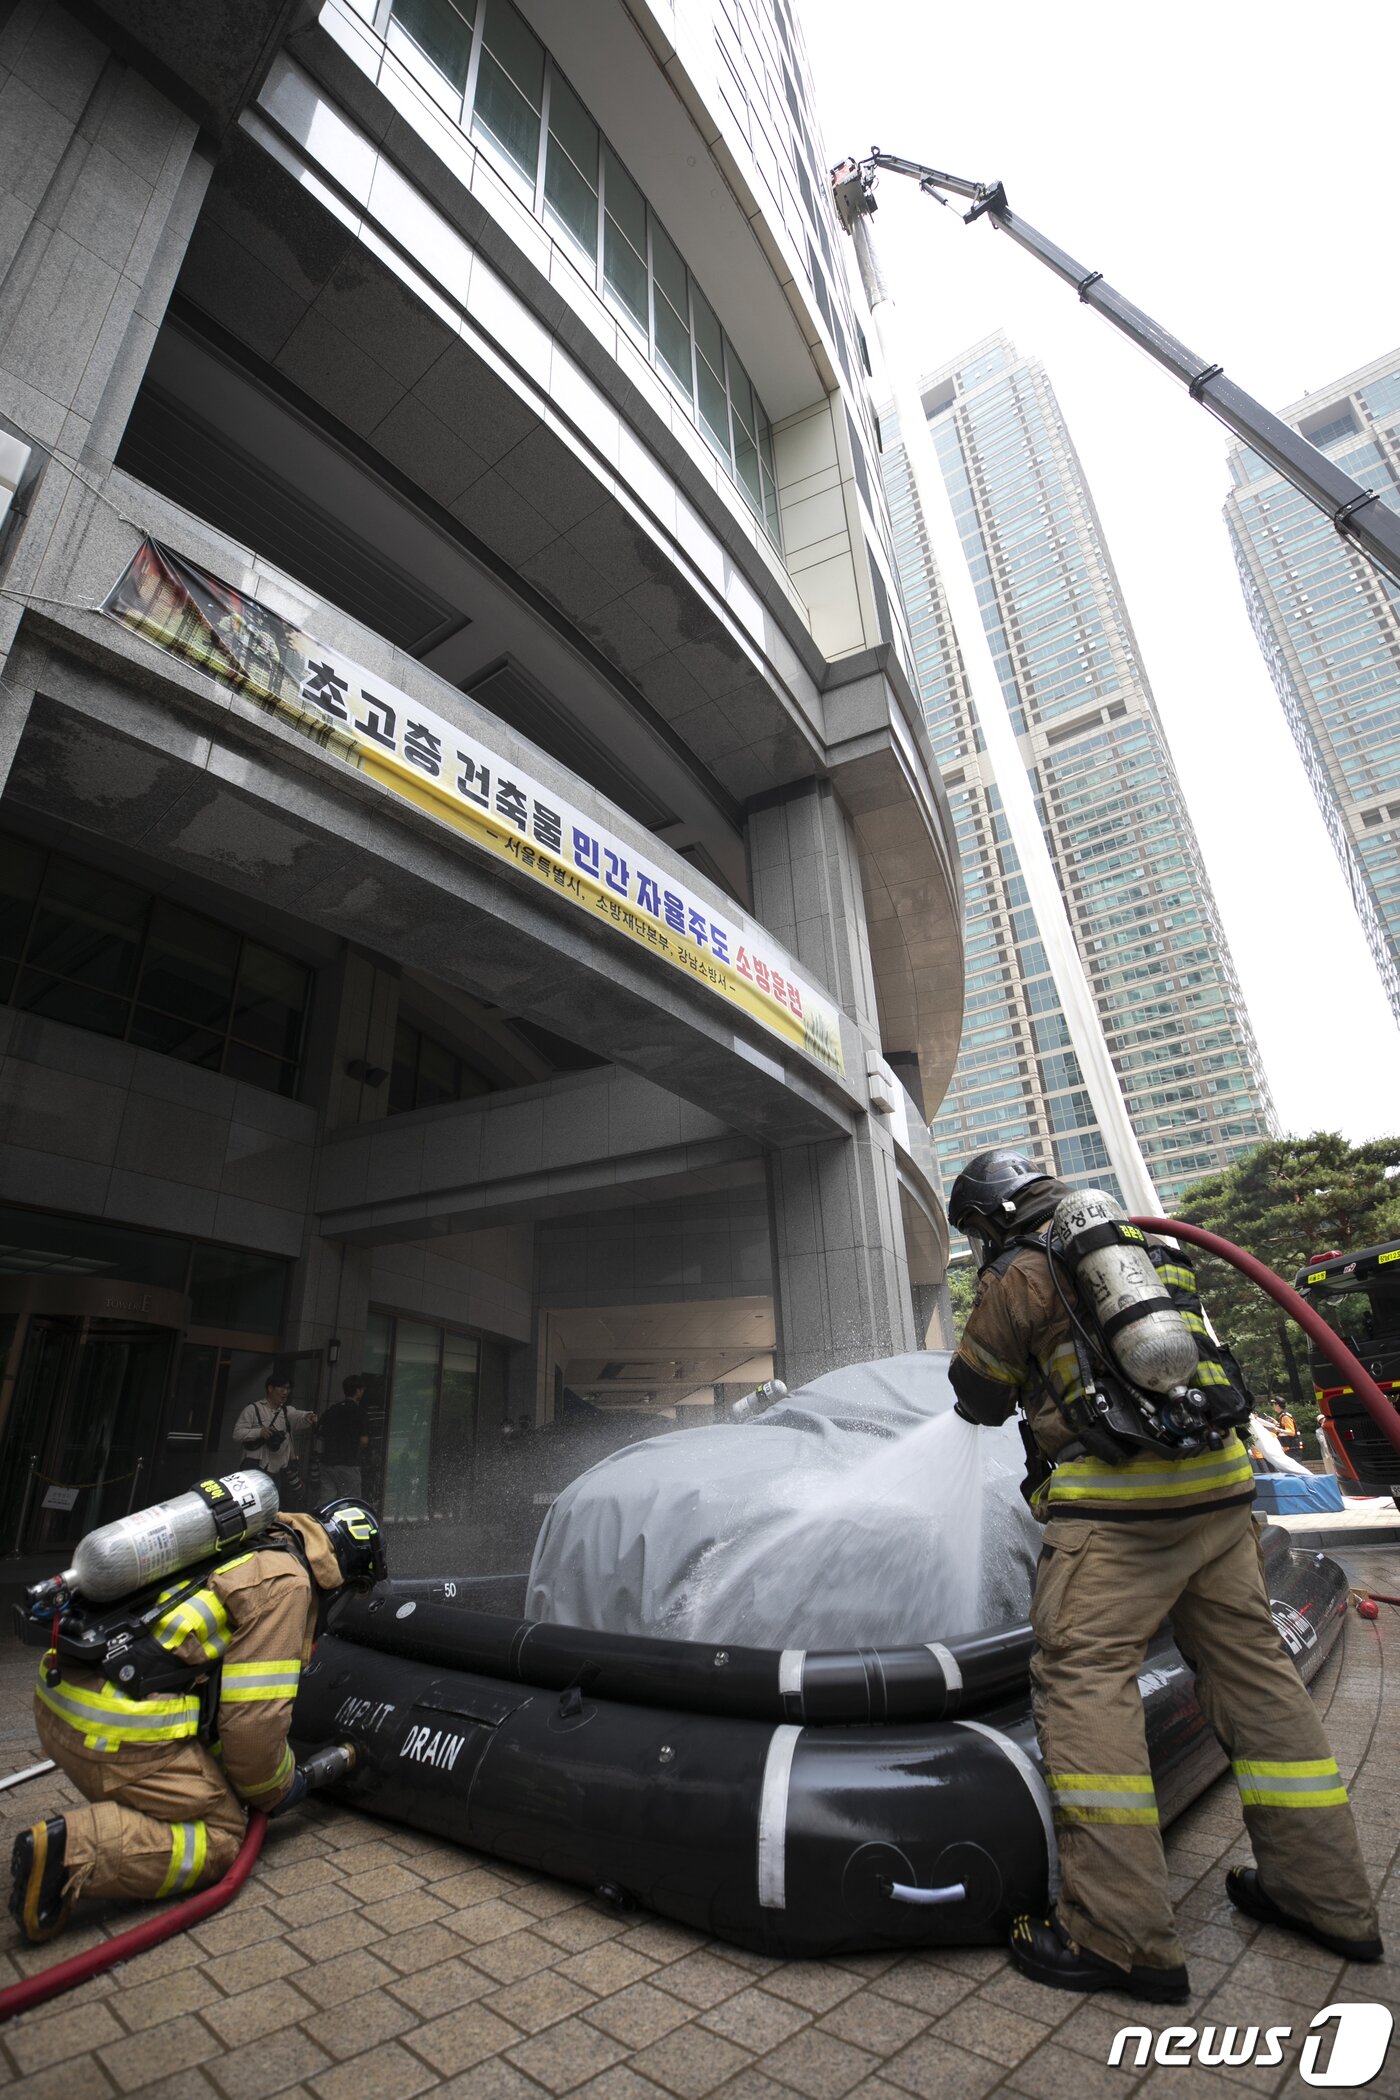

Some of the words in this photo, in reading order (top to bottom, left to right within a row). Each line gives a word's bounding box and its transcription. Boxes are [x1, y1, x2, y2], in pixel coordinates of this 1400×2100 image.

[302, 659, 443, 778] 초고층
[456, 749, 562, 856] 건축물
[571, 825, 630, 898] 민간
[635, 869, 731, 966] 자율주도
[735, 945, 804, 1020] 소방훈련
[504, 836, 586, 901] 서울특별시,
[595, 895, 674, 957] 소방재난본부,
[677, 946, 728, 992] 강남소방서
[444, 1582, 457, 1598] 50
[399, 1725, 466, 1771] DRAIN
